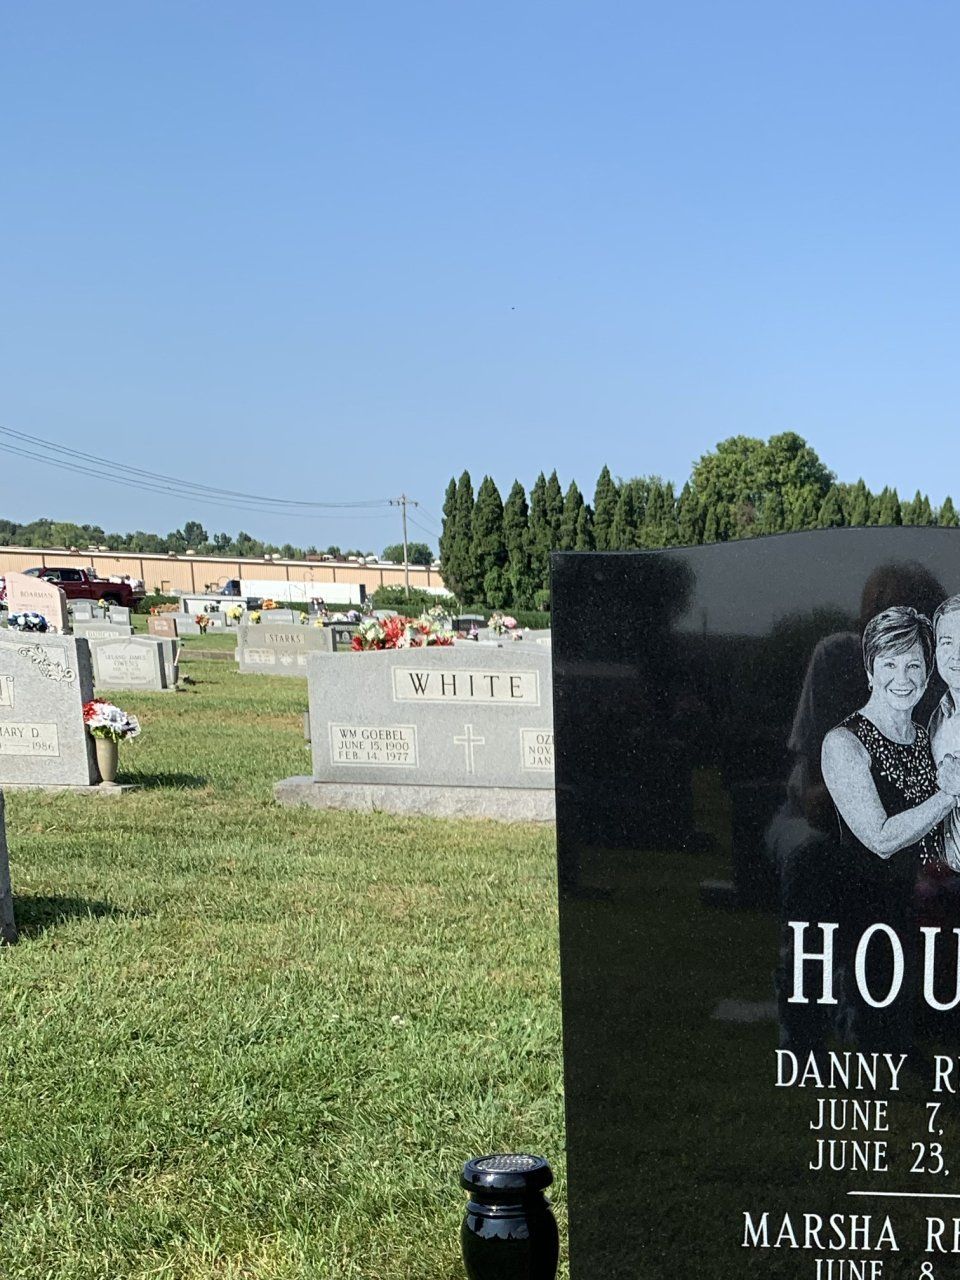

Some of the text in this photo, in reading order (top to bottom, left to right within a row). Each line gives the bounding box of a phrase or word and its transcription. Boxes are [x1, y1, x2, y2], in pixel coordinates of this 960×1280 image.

[269, 633, 301, 643] STARKS
[408, 672, 524, 698] WHITE
[32, 728, 39, 738] D
[339, 728, 406, 740] WM GOEBEL
[32, 742, 55, 751] 1986
[338, 741, 365, 750] JUNE
[386, 741, 409, 751] 1900
[387, 752, 409, 761] 1977
[775, 1050, 907, 1090] DANNY
[810, 1099, 888, 1131] JUNE
[926, 1103, 943, 1135] 7,
[810, 1140, 887, 1171] JUNE
[910, 1142, 949, 1176] 23,
[742, 1212, 899, 1251] MARSHA
